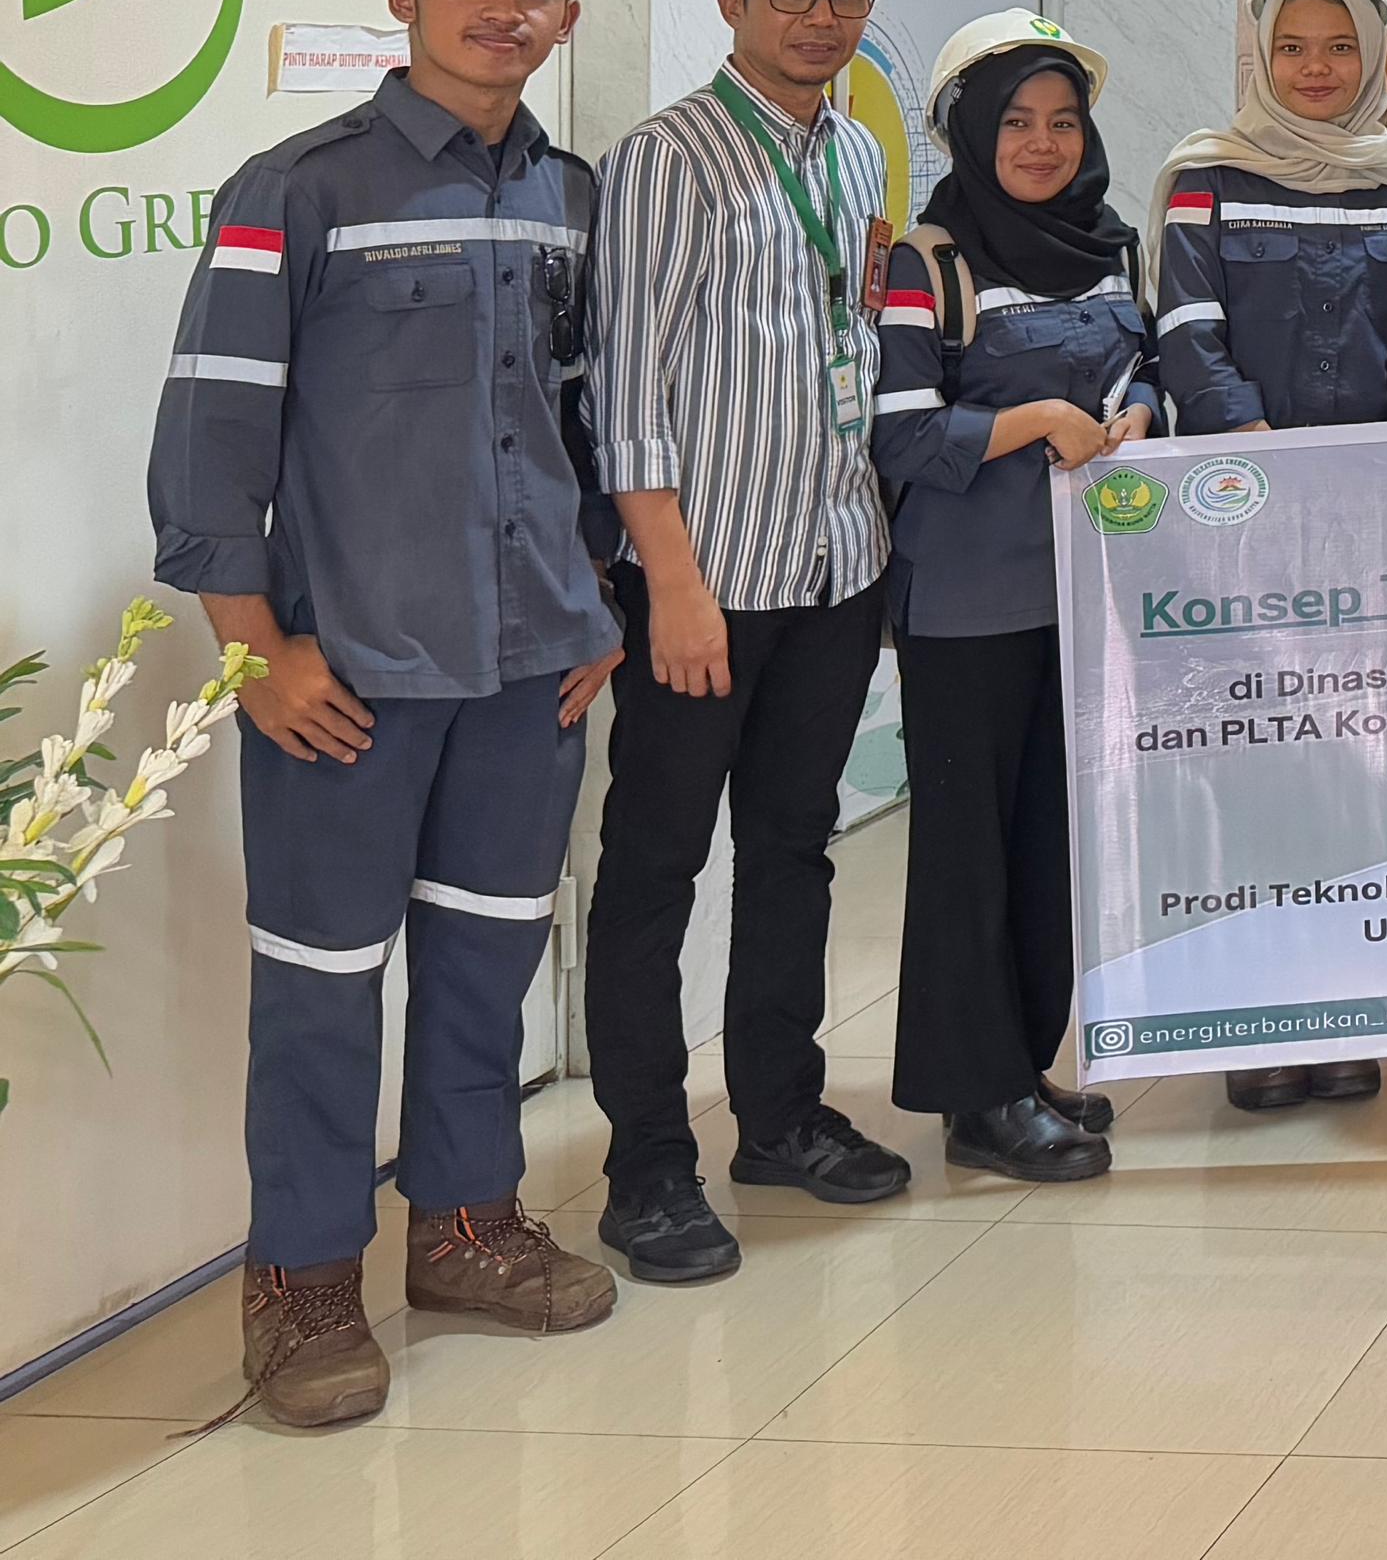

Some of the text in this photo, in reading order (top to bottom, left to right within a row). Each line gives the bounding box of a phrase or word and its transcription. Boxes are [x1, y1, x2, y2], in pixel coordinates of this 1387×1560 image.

[283, 52, 307, 67] PINTU
[308, 52, 337, 67] HARAP
[339, 53, 372, 68] DITUTUP
[79, 186, 215, 259] GRE
[364, 246, 409, 262] RIVALDO
[1141, 581, 1362, 631] Konsep
[1228, 672, 1263, 702] di
[1276, 665, 1387, 698] Dinas
[1135, 722, 1208, 753] dan
[1221, 713, 1323, 746] PLTA
[1160, 884, 1257, 917] Prodi
